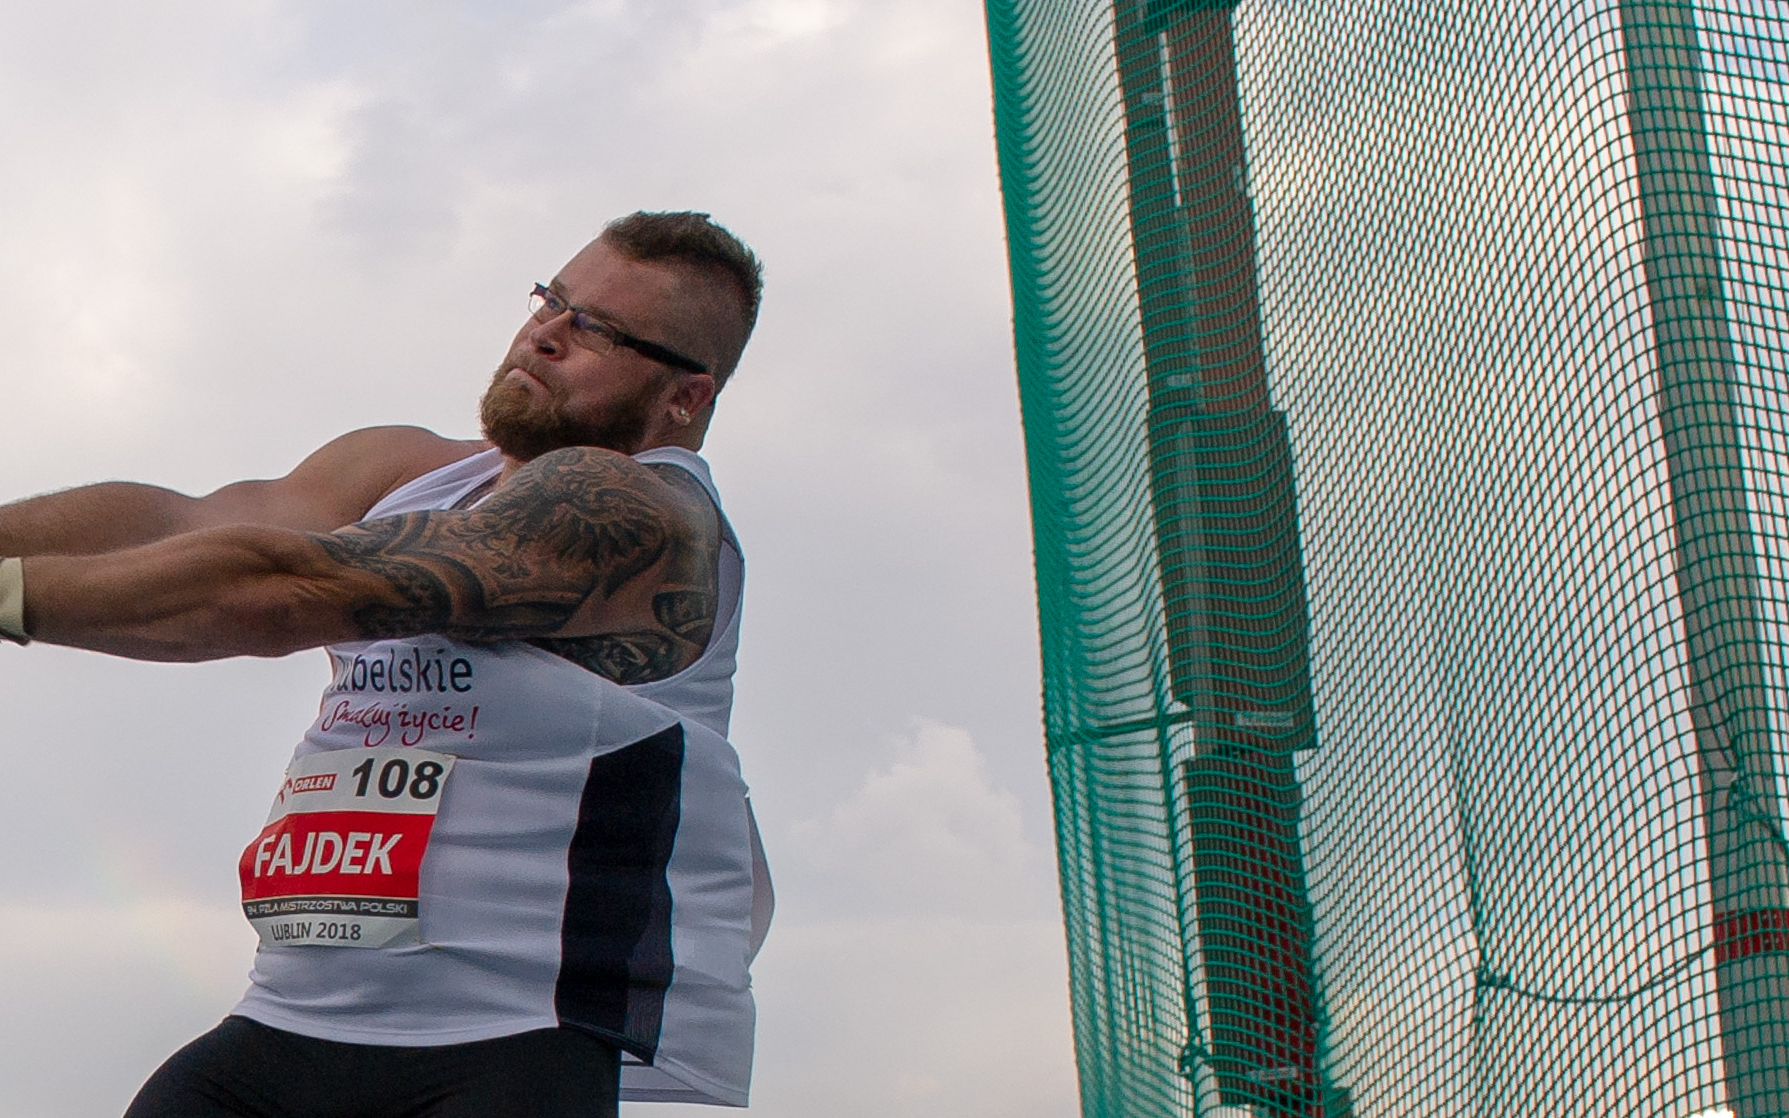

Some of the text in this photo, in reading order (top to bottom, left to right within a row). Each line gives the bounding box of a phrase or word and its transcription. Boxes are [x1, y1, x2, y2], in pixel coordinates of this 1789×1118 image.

[399, 703, 479, 746] życie!
[295, 777, 333, 790] ORLEN
[352, 758, 443, 799] 108
[253, 831, 403, 877] FAJDEK
[360, 902, 408, 914] POLSKI
[271, 922, 362, 941] LUBLIN 2018
